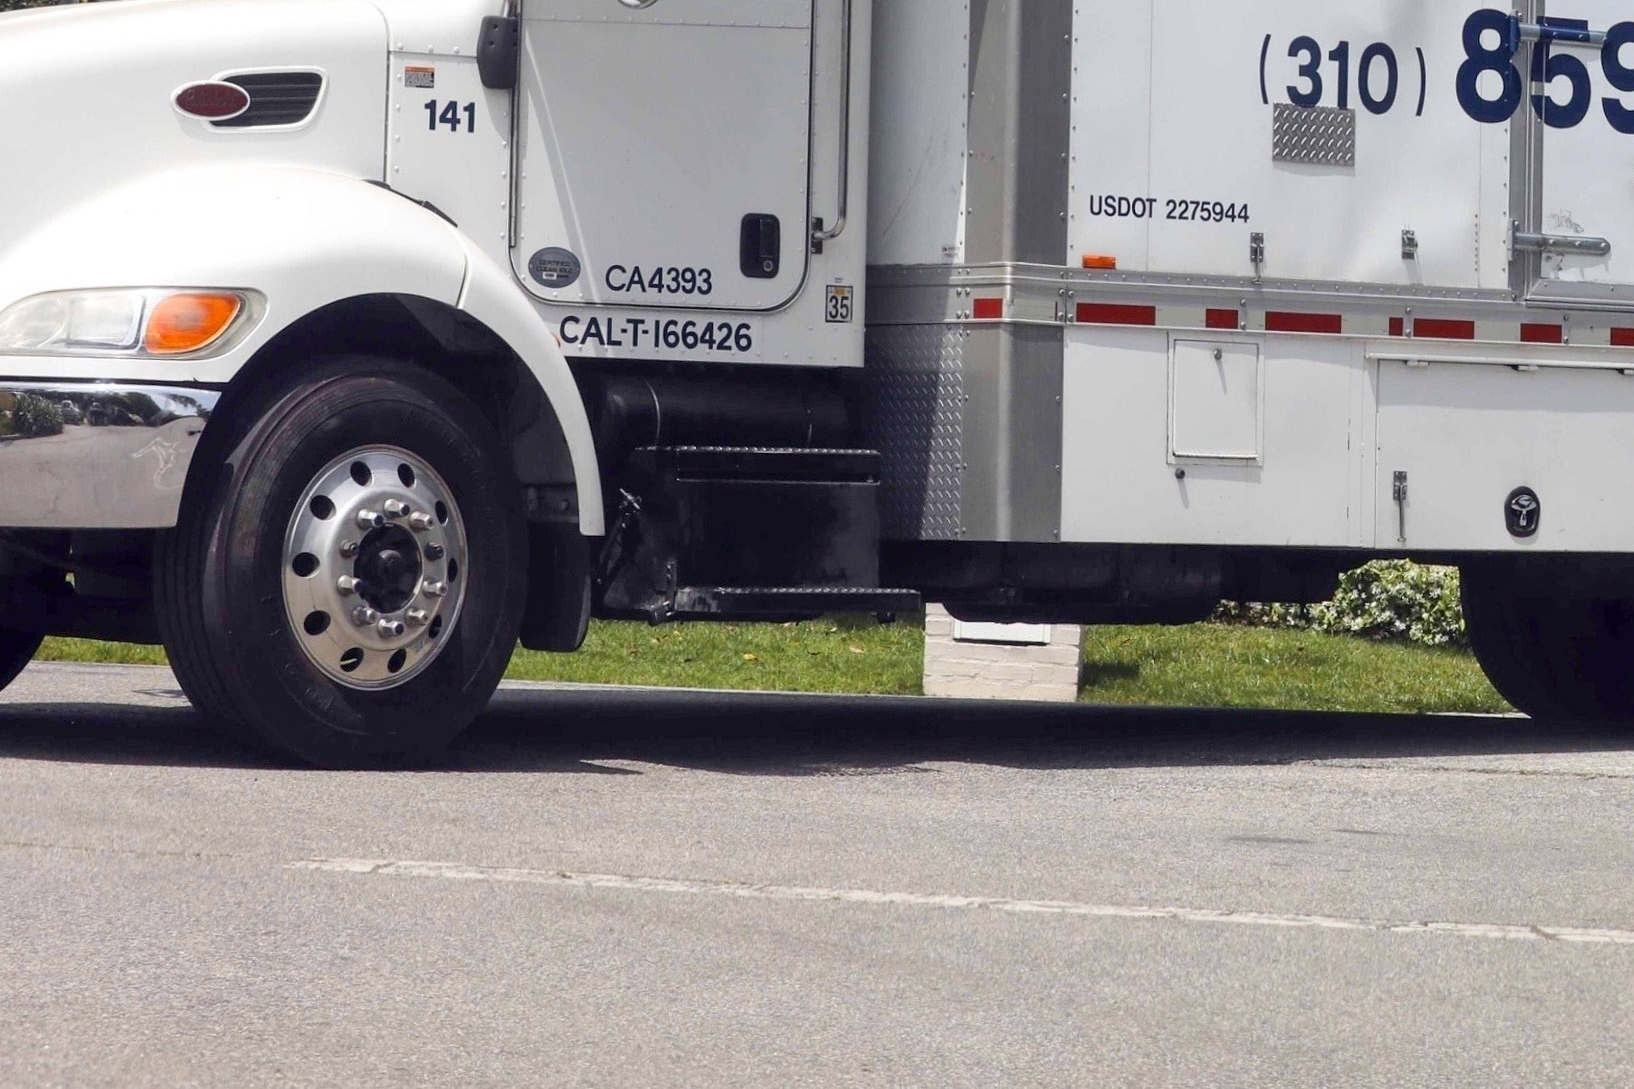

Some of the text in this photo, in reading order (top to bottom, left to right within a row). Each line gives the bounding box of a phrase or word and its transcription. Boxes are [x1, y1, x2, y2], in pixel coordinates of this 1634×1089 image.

[1258, 33, 1427, 117] (310)
[424, 99, 476, 134] 141
[1088, 194, 1250, 224] USDOT 2275944
[605, 264, 714, 296] CA4393
[828, 294, 850, 320] 35
